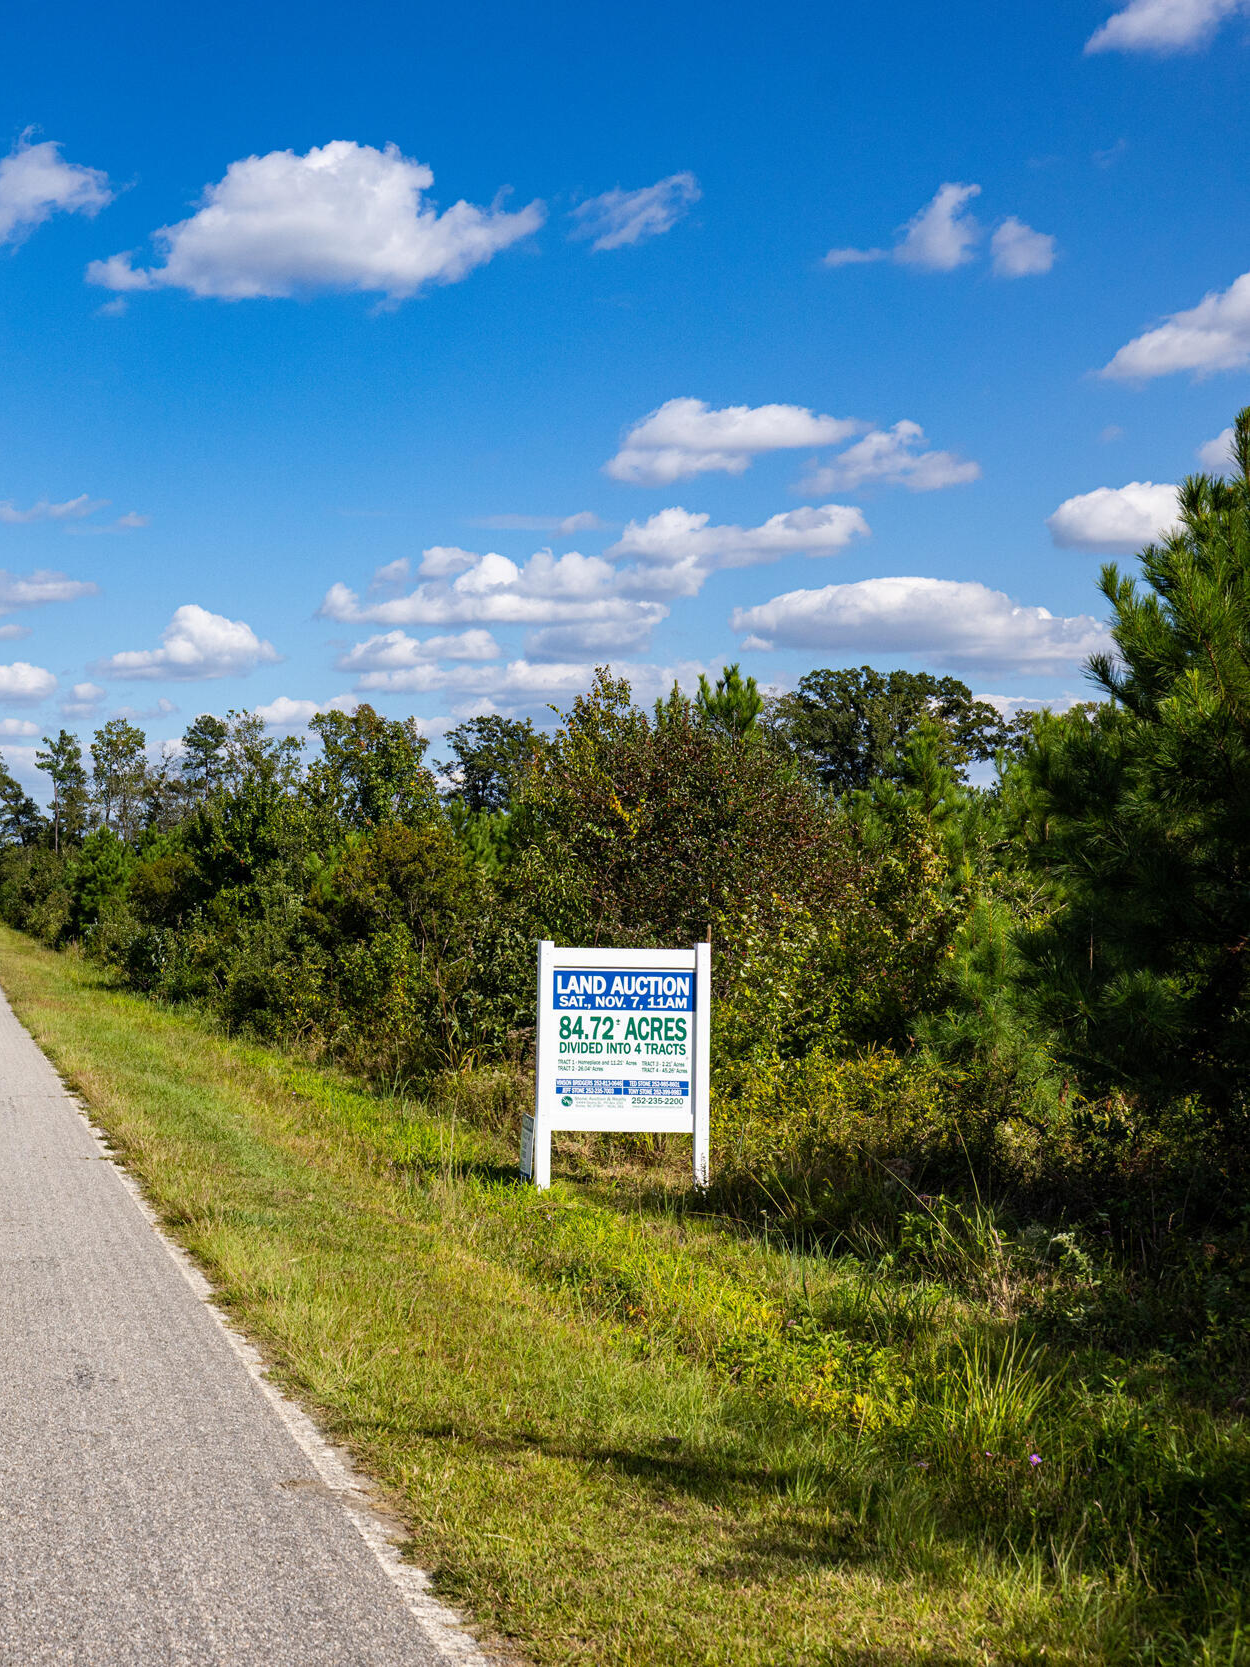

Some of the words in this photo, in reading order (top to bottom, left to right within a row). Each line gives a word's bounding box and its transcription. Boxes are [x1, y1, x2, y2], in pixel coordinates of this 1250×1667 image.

[557, 975, 607, 995] LAND
[610, 975, 690, 996] AUCTION
[559, 995, 592, 1010] SAT.,
[595, 996, 626, 1008] NOV.
[630, 996, 644, 1010] 7,
[647, 996, 688, 1009] 11AM
[624, 1016, 688, 1042] ACRES
[559, 1042, 603, 1054] DIVIDED
[606, 1042, 632, 1054] INTO
[634, 1043, 642, 1055] 4
[644, 1043, 687, 1056] TRACTS
[631, 1097, 684, 1105] 252-235-2200
